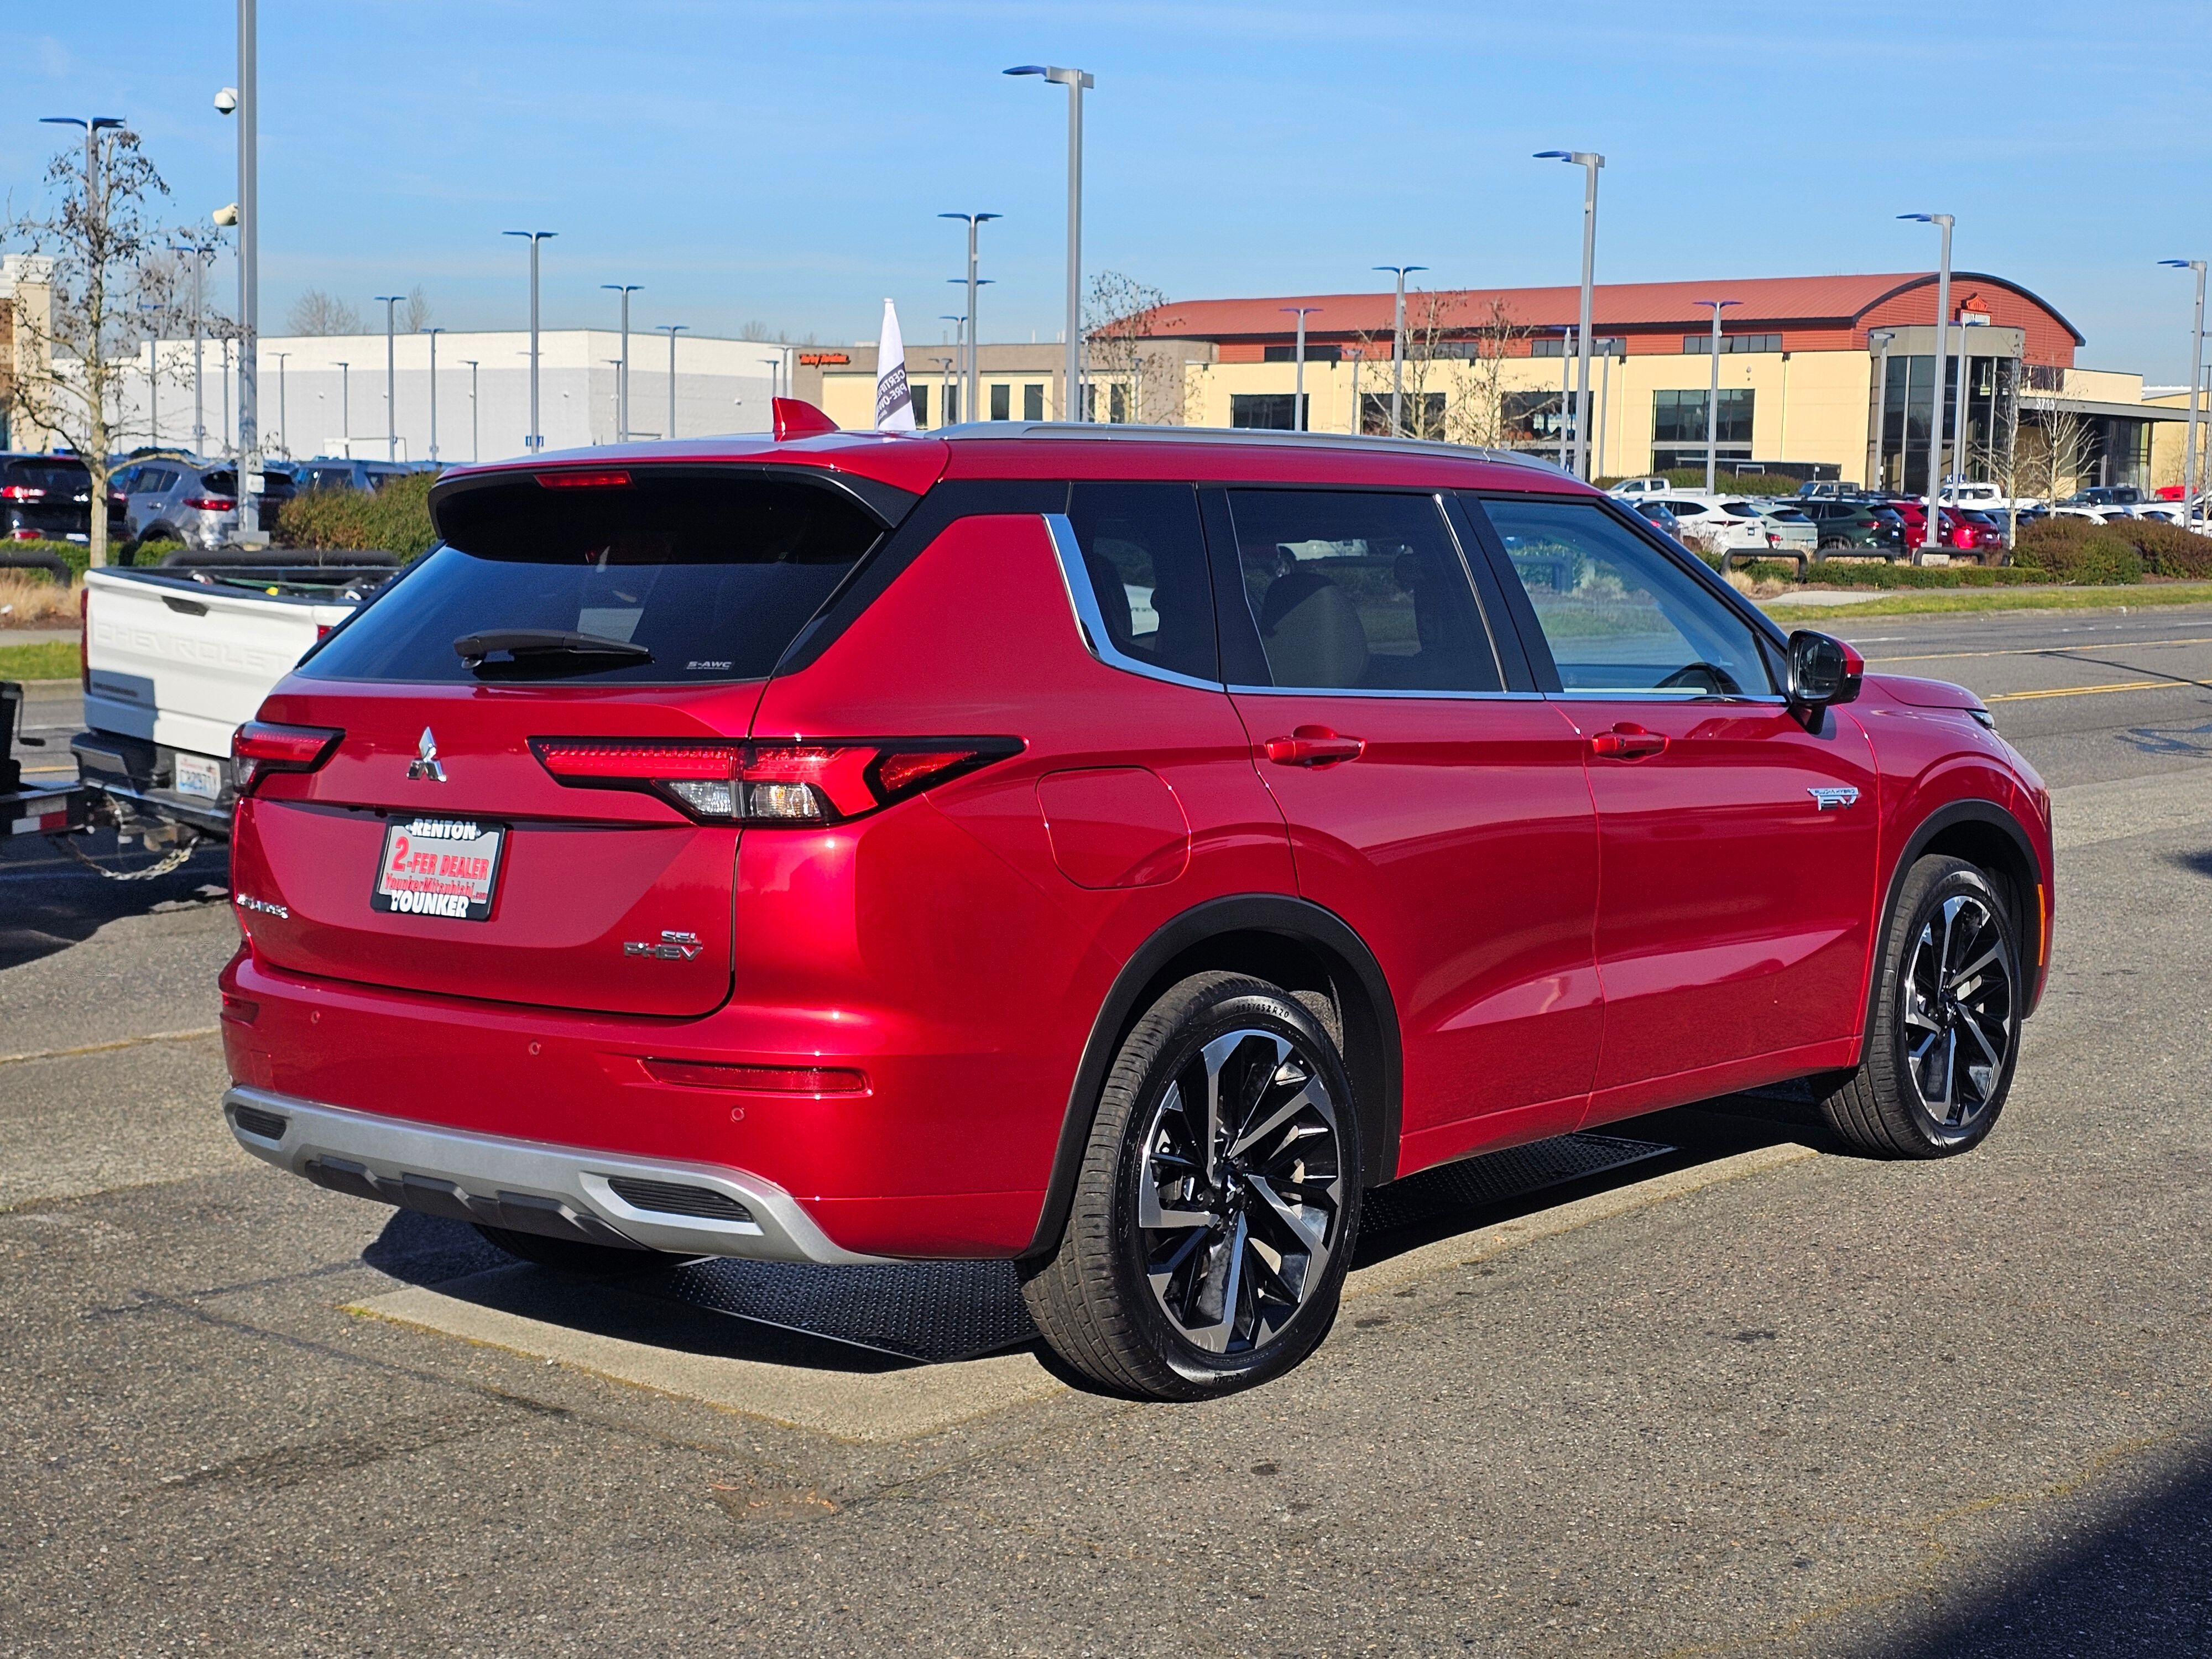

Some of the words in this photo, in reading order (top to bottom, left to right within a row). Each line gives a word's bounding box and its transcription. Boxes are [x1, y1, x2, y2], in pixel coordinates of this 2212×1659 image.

[411, 818, 477, 840] RENTON
[392, 836, 437, 875] 2-FER
[439, 855, 489, 880] DEALER
[390, 890, 469, 918] YOUNKER
[624, 942, 703, 961] PHEV
